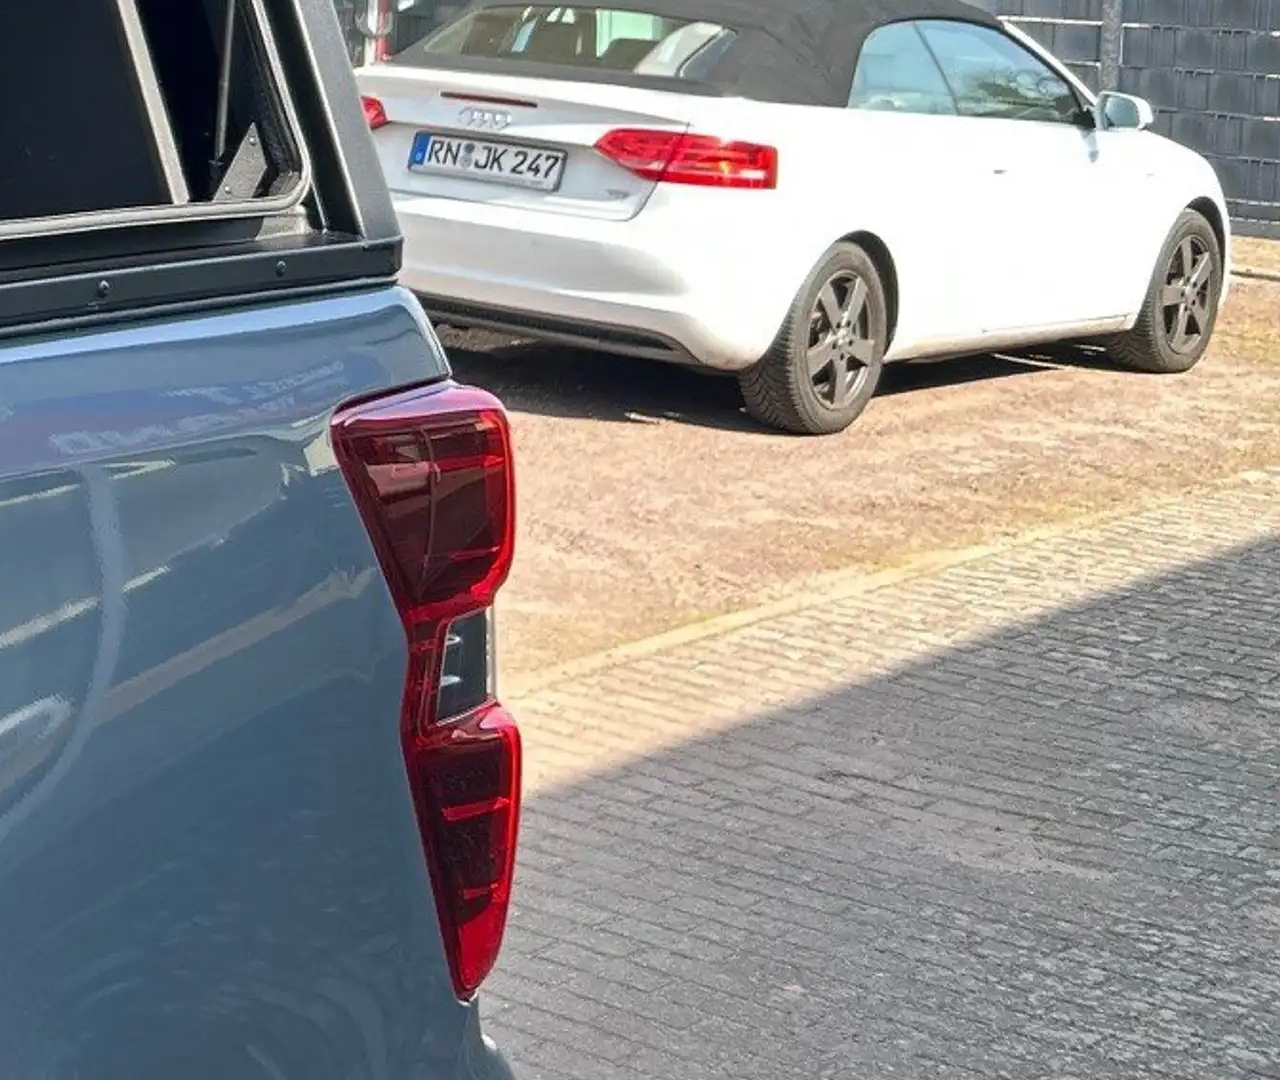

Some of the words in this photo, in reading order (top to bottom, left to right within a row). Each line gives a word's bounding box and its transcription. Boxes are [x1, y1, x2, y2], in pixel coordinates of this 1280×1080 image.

[427, 138, 462, 165] RN
[474, 146, 509, 173] JK
[510, 150, 560, 179] 247
